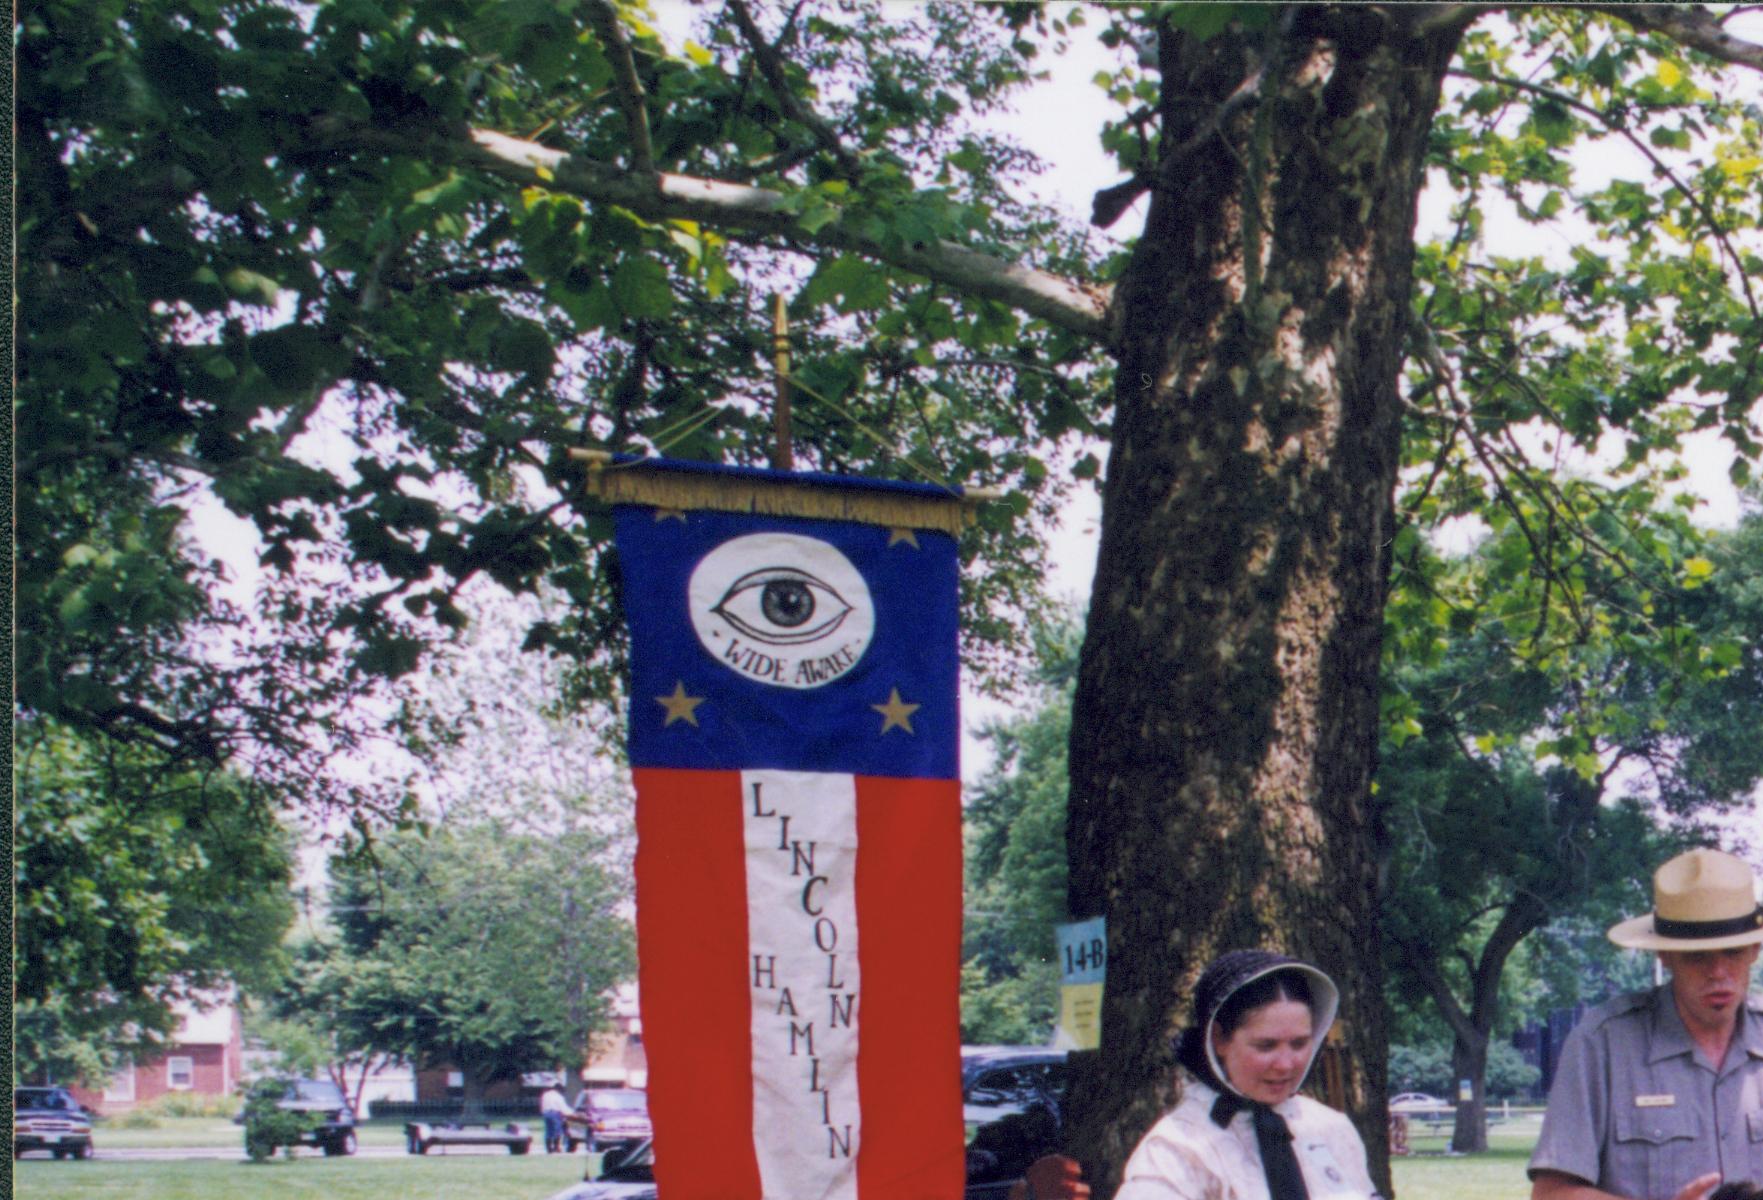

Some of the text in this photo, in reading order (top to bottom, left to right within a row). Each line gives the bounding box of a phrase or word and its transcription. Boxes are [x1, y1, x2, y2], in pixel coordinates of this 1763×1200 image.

[724, 638, 859, 685] WIDE AWAKE
[751, 782, 856, 1029] LINCOLN
[1065, 938, 1104, 975] 14-B
[753, 955, 852, 1159] HAMLIN
